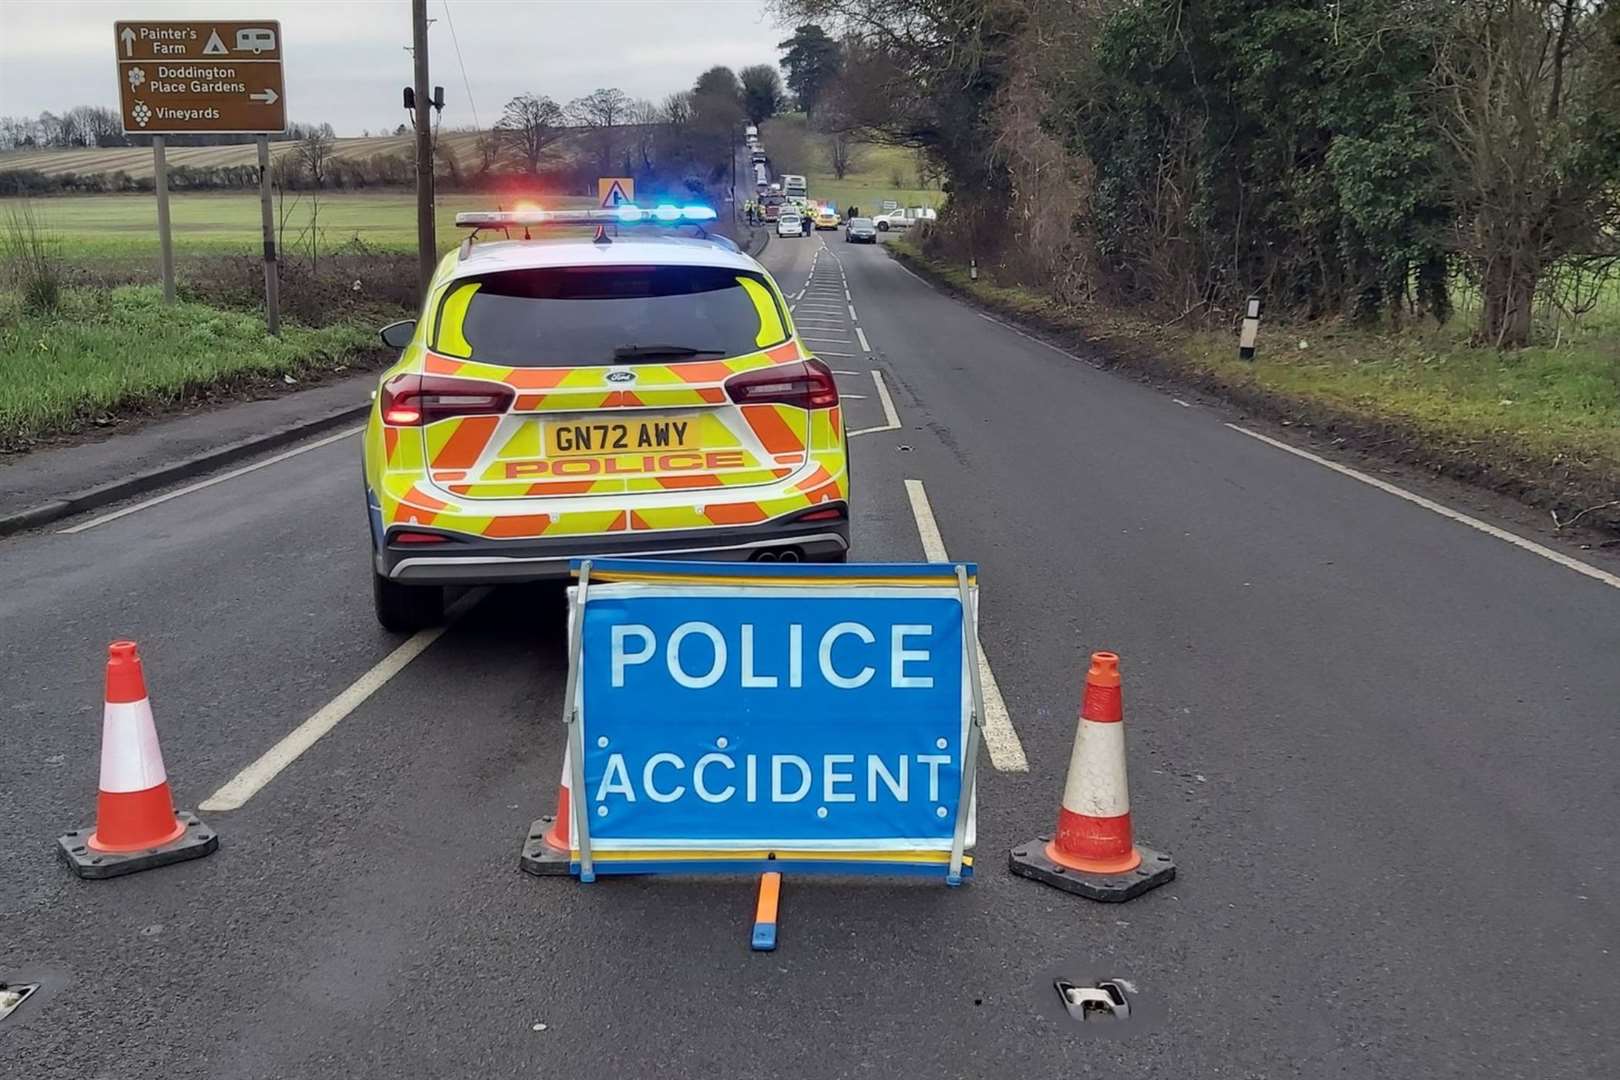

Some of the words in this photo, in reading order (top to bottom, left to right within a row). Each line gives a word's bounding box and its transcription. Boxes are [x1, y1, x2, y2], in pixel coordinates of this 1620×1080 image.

[140, 27, 197, 40] Painter's
[153, 42, 186, 54] Farm
[158, 66, 235, 80] Doddington
[150, 81, 186, 93] Place
[190, 81, 246, 93] Gardens
[156, 107, 220, 121] Vineyards
[555, 424, 629, 452] GN72
[637, 421, 688, 447] AWY
[504, 451, 745, 480] POLICE
[610, 621, 934, 689] POLICE
[595, 752, 952, 803] ACCIDENT
